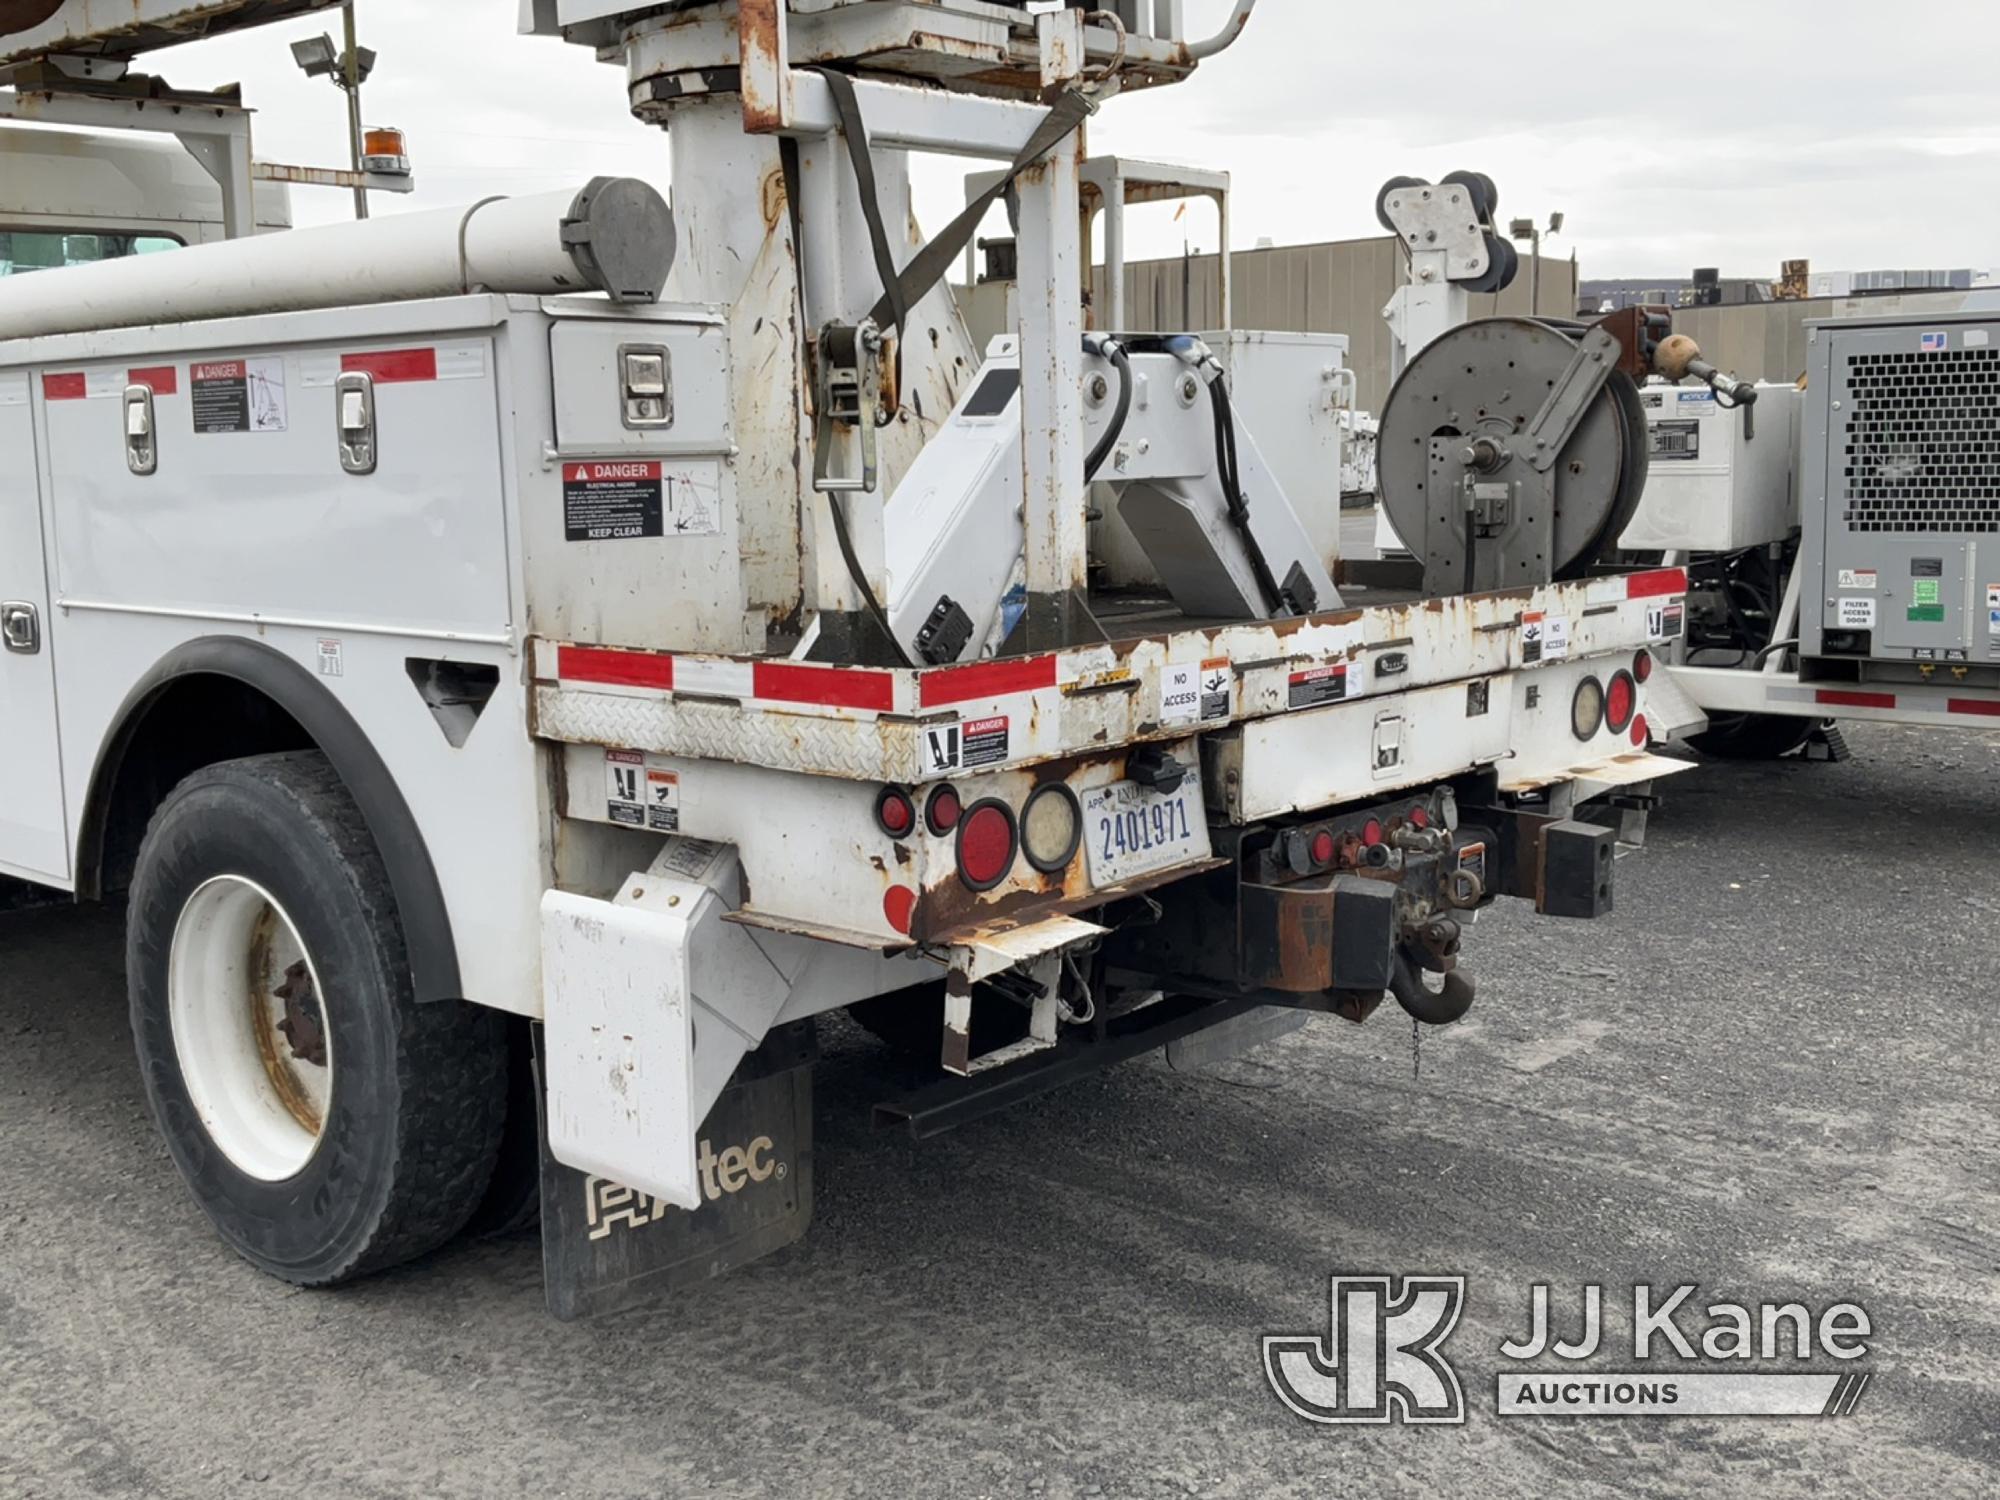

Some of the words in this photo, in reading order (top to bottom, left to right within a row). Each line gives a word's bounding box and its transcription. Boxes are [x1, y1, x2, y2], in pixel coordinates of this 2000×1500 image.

[204, 364, 238, 378] DANGER
[594, 464, 648, 477] DANGER
[588, 529, 611, 538] KEEP
[613, 526, 643, 537] CLEAR
[1174, 673, 1187, 684] NO
[1164, 692, 1197, 708] ACCESS
[976, 719, 1004, 730] DANGER
[1100, 797, 1191, 861] 2401971
